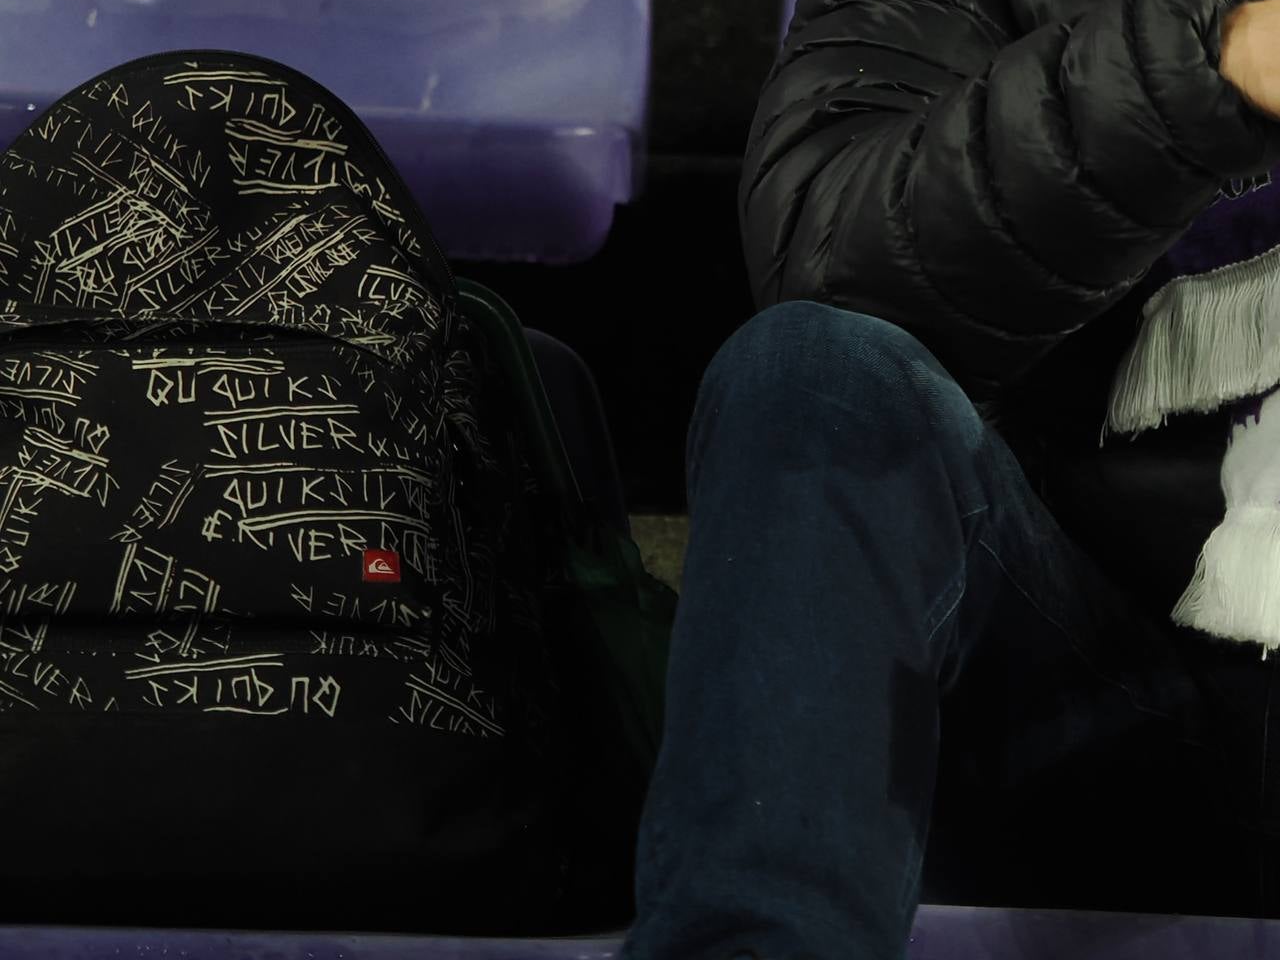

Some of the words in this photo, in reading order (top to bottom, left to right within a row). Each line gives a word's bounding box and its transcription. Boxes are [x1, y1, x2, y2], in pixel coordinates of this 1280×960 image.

[145, 368, 197, 408] QU
[211, 373, 343, 410] QUIKS
[209, 417, 366, 459] SILVER
